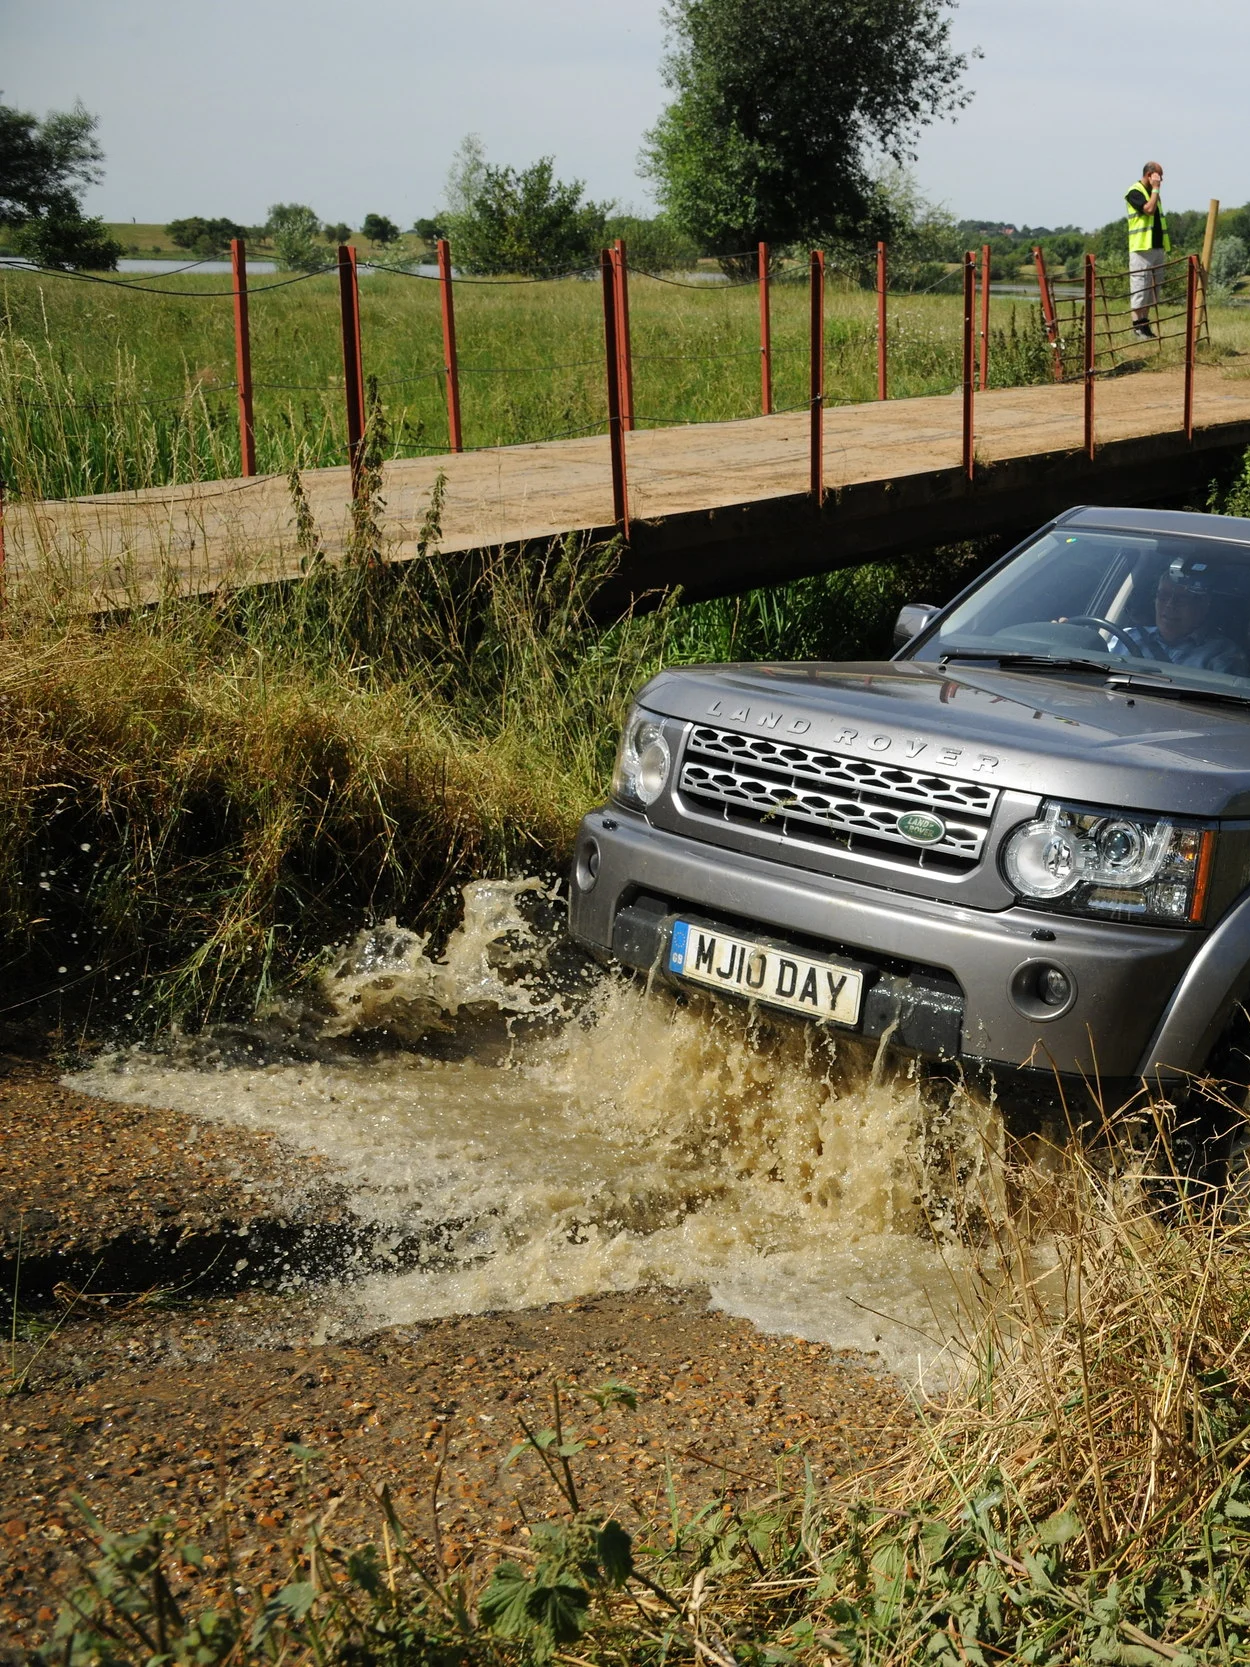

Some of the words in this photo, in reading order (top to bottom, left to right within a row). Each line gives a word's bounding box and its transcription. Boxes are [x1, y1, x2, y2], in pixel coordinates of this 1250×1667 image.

[705, 700, 812, 735] LAND
[833, 726, 1000, 774] ROVER
[907, 817, 930, 828] LAND
[908, 825, 935, 837] ROVER
[671, 952, 684, 965] GB
[695, 934, 767, 989] MJ10
[775, 958, 847, 1011] DAY
